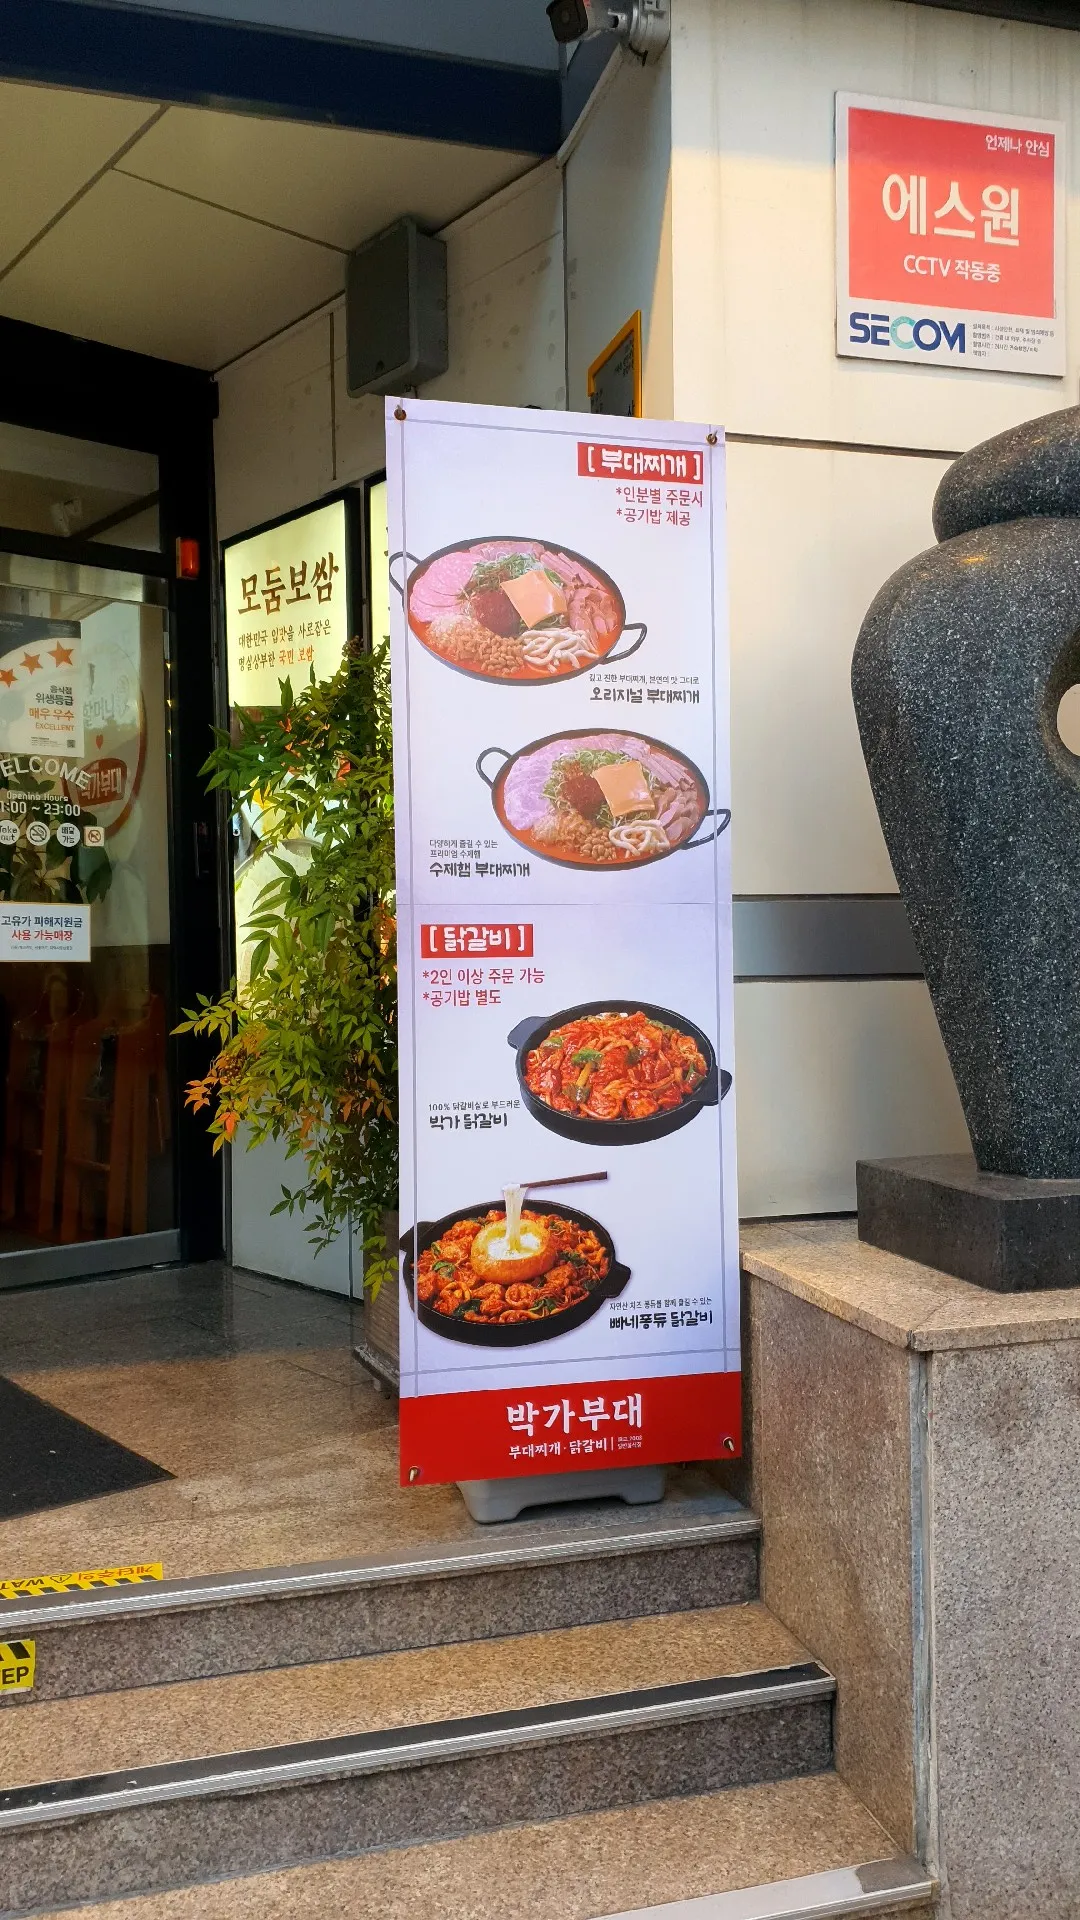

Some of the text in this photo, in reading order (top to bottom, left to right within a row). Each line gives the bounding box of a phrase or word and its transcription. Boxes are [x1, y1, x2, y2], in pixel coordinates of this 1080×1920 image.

[985, 134, 1050, 158] 언제나 안심
[882, 173, 1020, 247] 에스원
[903, 254, 1001, 283] CCTV 작동중
[849, 311, 966, 354] SECOM
[666, 489, 703, 507] 주문시
[666, 510, 690, 526] 제공
[238, 551, 339, 615] 모둠보쌈
[238, 618, 331, 648] 대한민국 입맛을 사로잡은
[238, 644, 314, 671] 명실상부한 국민 보쌈
[604, 674, 617, 682] 진한
[650, 675, 670, 684] 본연의
[671, 676, 678, 684] 맛
[680, 676, 699, 685] 그대로
[49, 684, 72, 694] 음식점
[590, 687, 699, 704] 오리지널 부대찌개
[36, 692, 73, 706] 위생등급
[29, 707, 74, 721] 매우 우수
[35, 721, 75, 732] EXCELLENT
[7, 790, 69, 802] Opening Hours
[44, 803, 80, 817] 23:00
[61, 826, 74, 835] 배달
[63, 836, 75, 844] 가능
[429, 839, 498, 849] 다양하게 즐길 수 있는
[430, 850, 481, 859] 프리미엄 수제햄
[429, 862, 530, 878] 수제햄 부대찌개
[1, 915, 83, 928] 고유가 피해지원금
[12, 930, 73, 941] 사용 가능매장
[457, 968, 484, 985] 이상
[488, 968, 515, 984] 주문
[519, 967, 545, 984] 가능
[475, 989, 501, 1006] 별도
[428, 1103, 451, 1111] 100%
[491, 1100, 520, 1109] 부드러운
[430, 1112, 507, 1130] 박가 닭갈비
[609, 1301, 628, 1310] 자연산
[629, 1301, 642, 1309] 치즈
[664, 1299, 677, 1308] 함께
[692, 1298, 699, 1306] 수
[700, 1296, 712, 1306] 있는
[609, 1310, 713, 1330] 빠네퐁듀 닭갈비
[507, 1393, 643, 1437] 박가부대
[509, 1441, 561, 1459] 부대찌개
[569, 1438, 607, 1455] 닭갈비
[78, 1565, 153, 1581] 계단주의
[0, 1666, 29, 1685] EP
